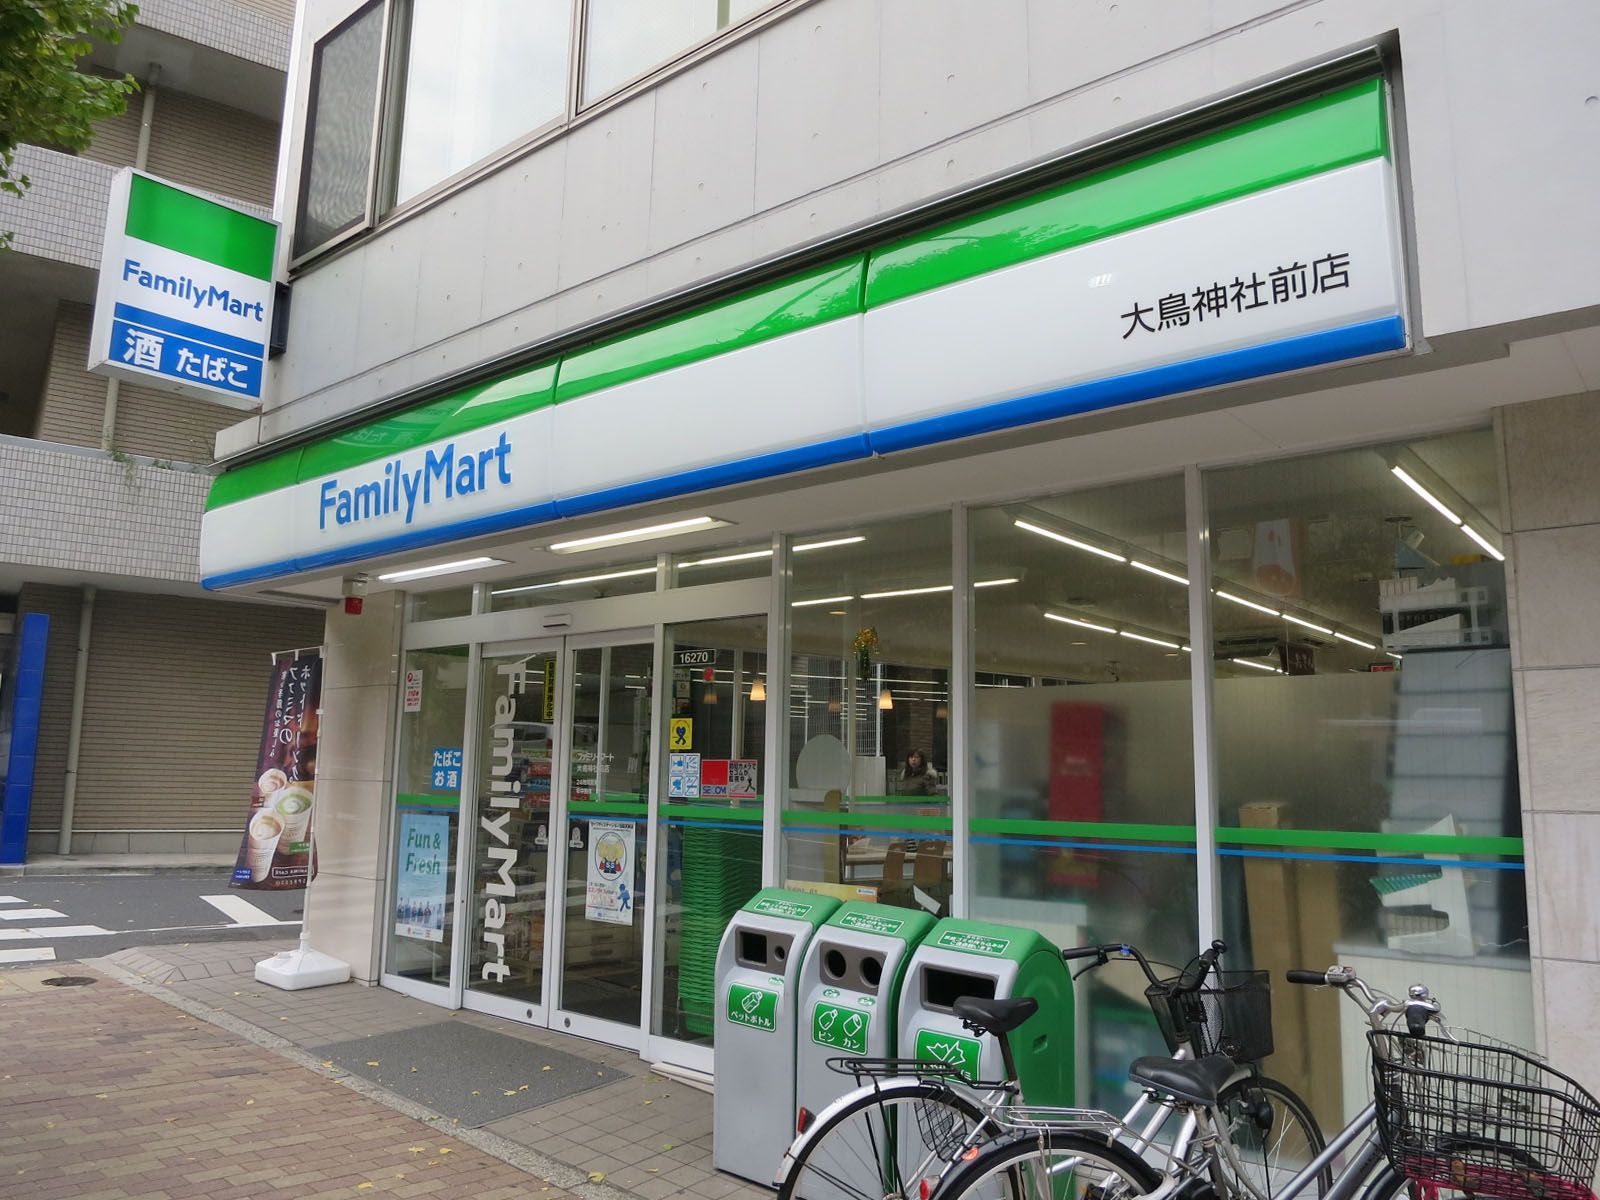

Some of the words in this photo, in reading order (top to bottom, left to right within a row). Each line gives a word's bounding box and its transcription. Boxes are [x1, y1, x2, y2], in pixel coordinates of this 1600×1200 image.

[122, 258, 264, 322] FamilyMart
[1120, 252, 1350, 340] 大鳥神社前店
[123, 328, 164, 371] 酒
[176, 347, 249, 389] たばこ
[319, 431, 512, 530] FamilyMart
[679, 651, 708, 664] 16270
[433, 750, 462, 767] たばこ
[434, 770, 458, 788] お酒
[702, 785, 727, 795] SECOM
[481, 662, 527, 984] FamilyMart
[407, 828, 431, 849] Fun
[432, 832, 442, 850] &
[405, 852, 441, 875] Fresh
[731, 1011, 772, 1027] ペットボトル
[818, 1030, 835, 1042] ビン
[842, 1037, 861, 1049] カン
